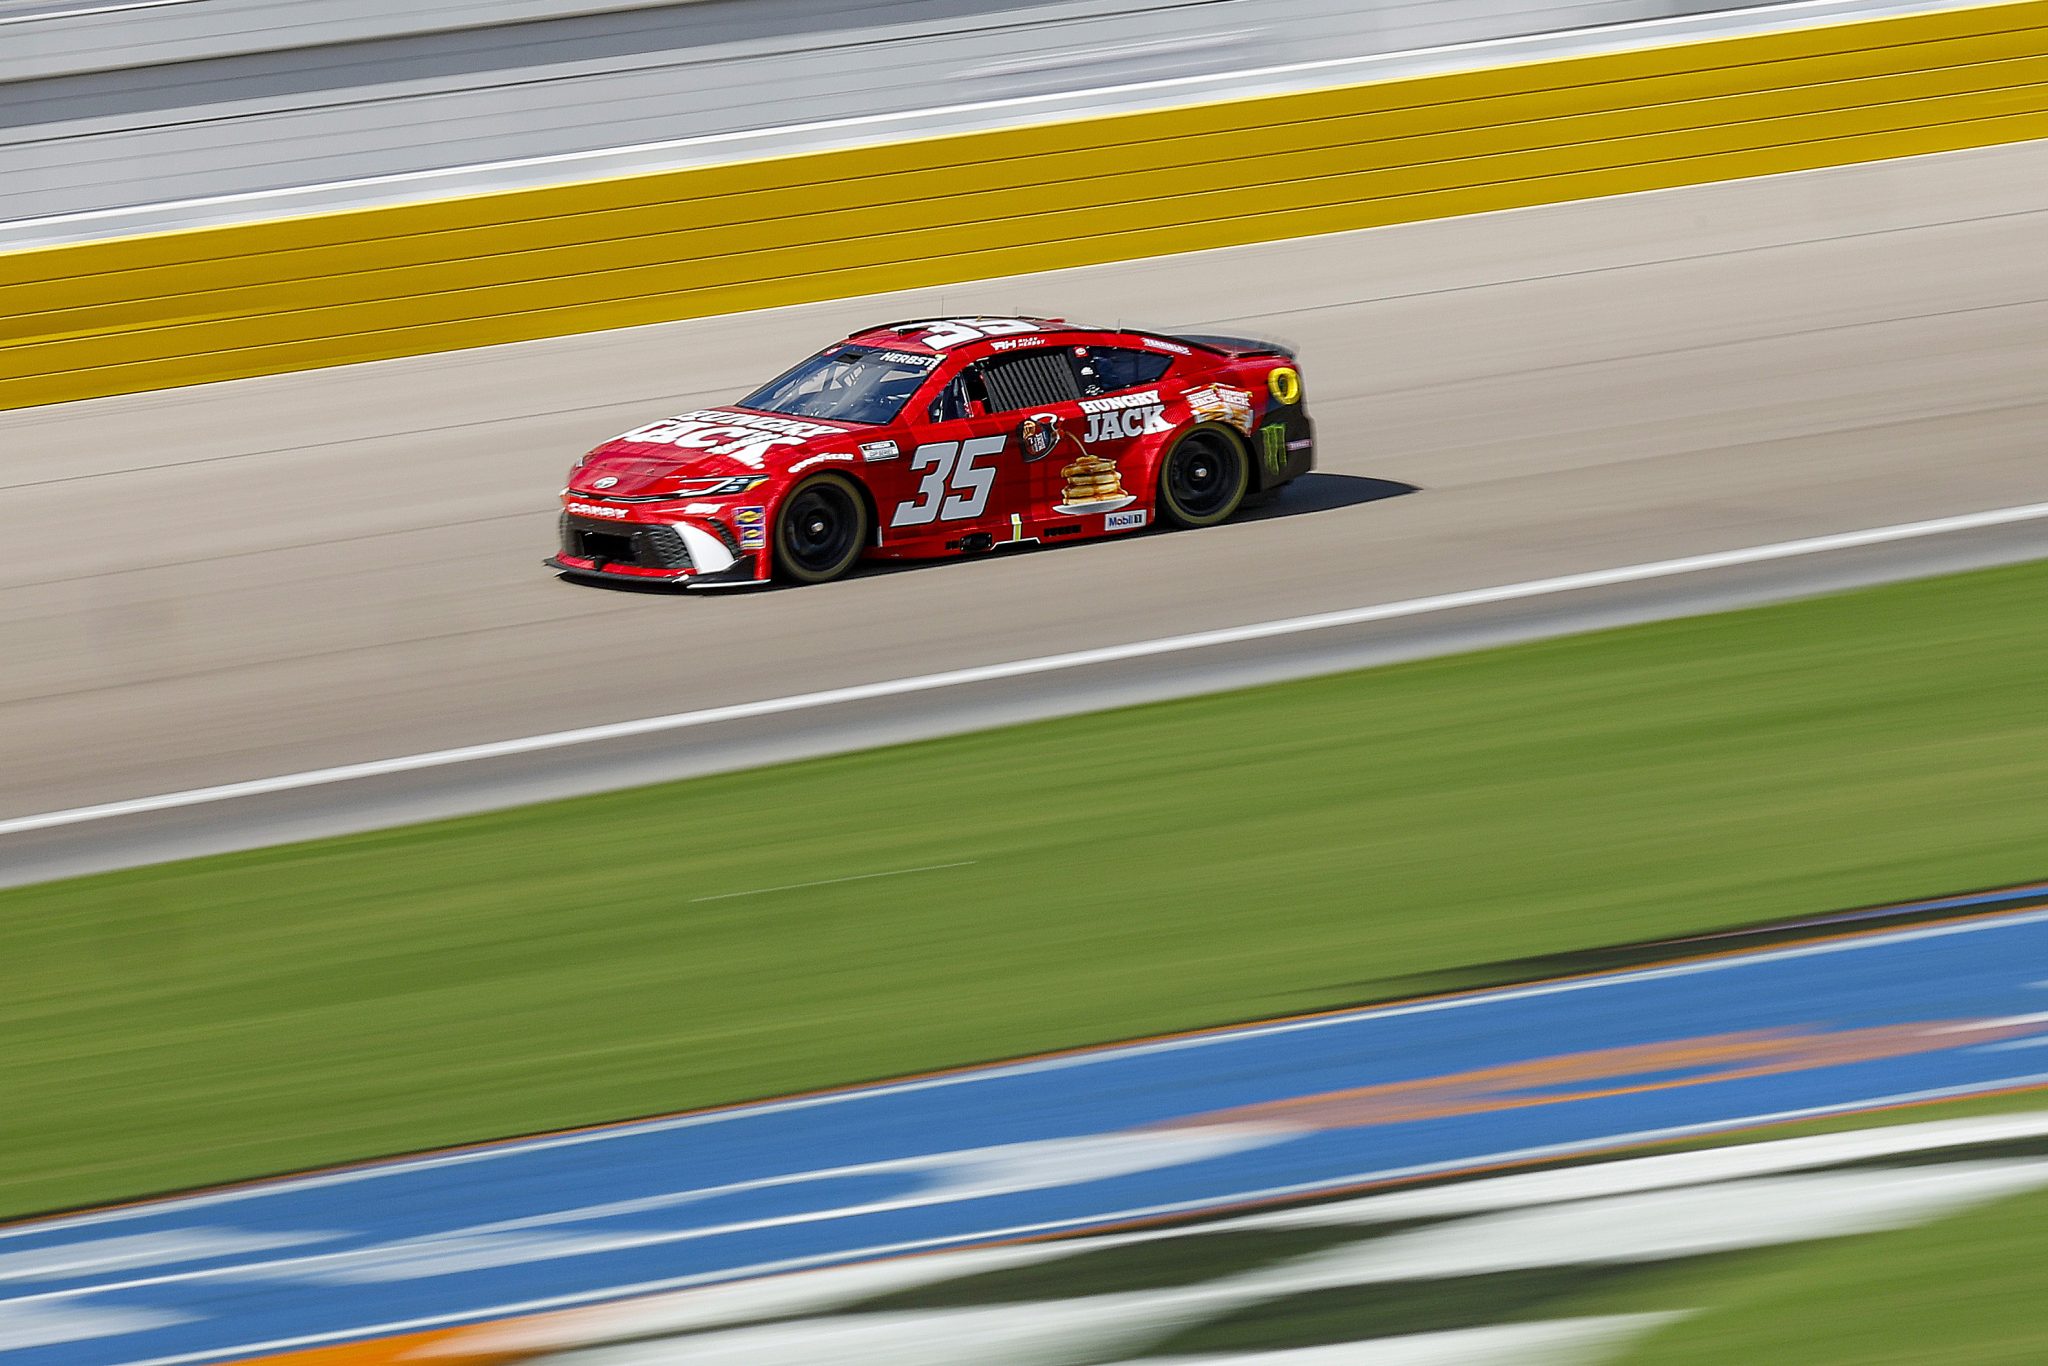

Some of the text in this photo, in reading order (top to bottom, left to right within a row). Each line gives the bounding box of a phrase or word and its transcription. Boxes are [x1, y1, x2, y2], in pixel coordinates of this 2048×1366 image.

[889, 318, 1040, 351] 35
[879, 351, 935, 368] HERBST
[1078, 389, 1161, 414] HUNGRY
[1083, 404, 1177, 443] JACK
[889, 434, 1007, 528] 35
[1108, 515, 1133, 527] Mobil
